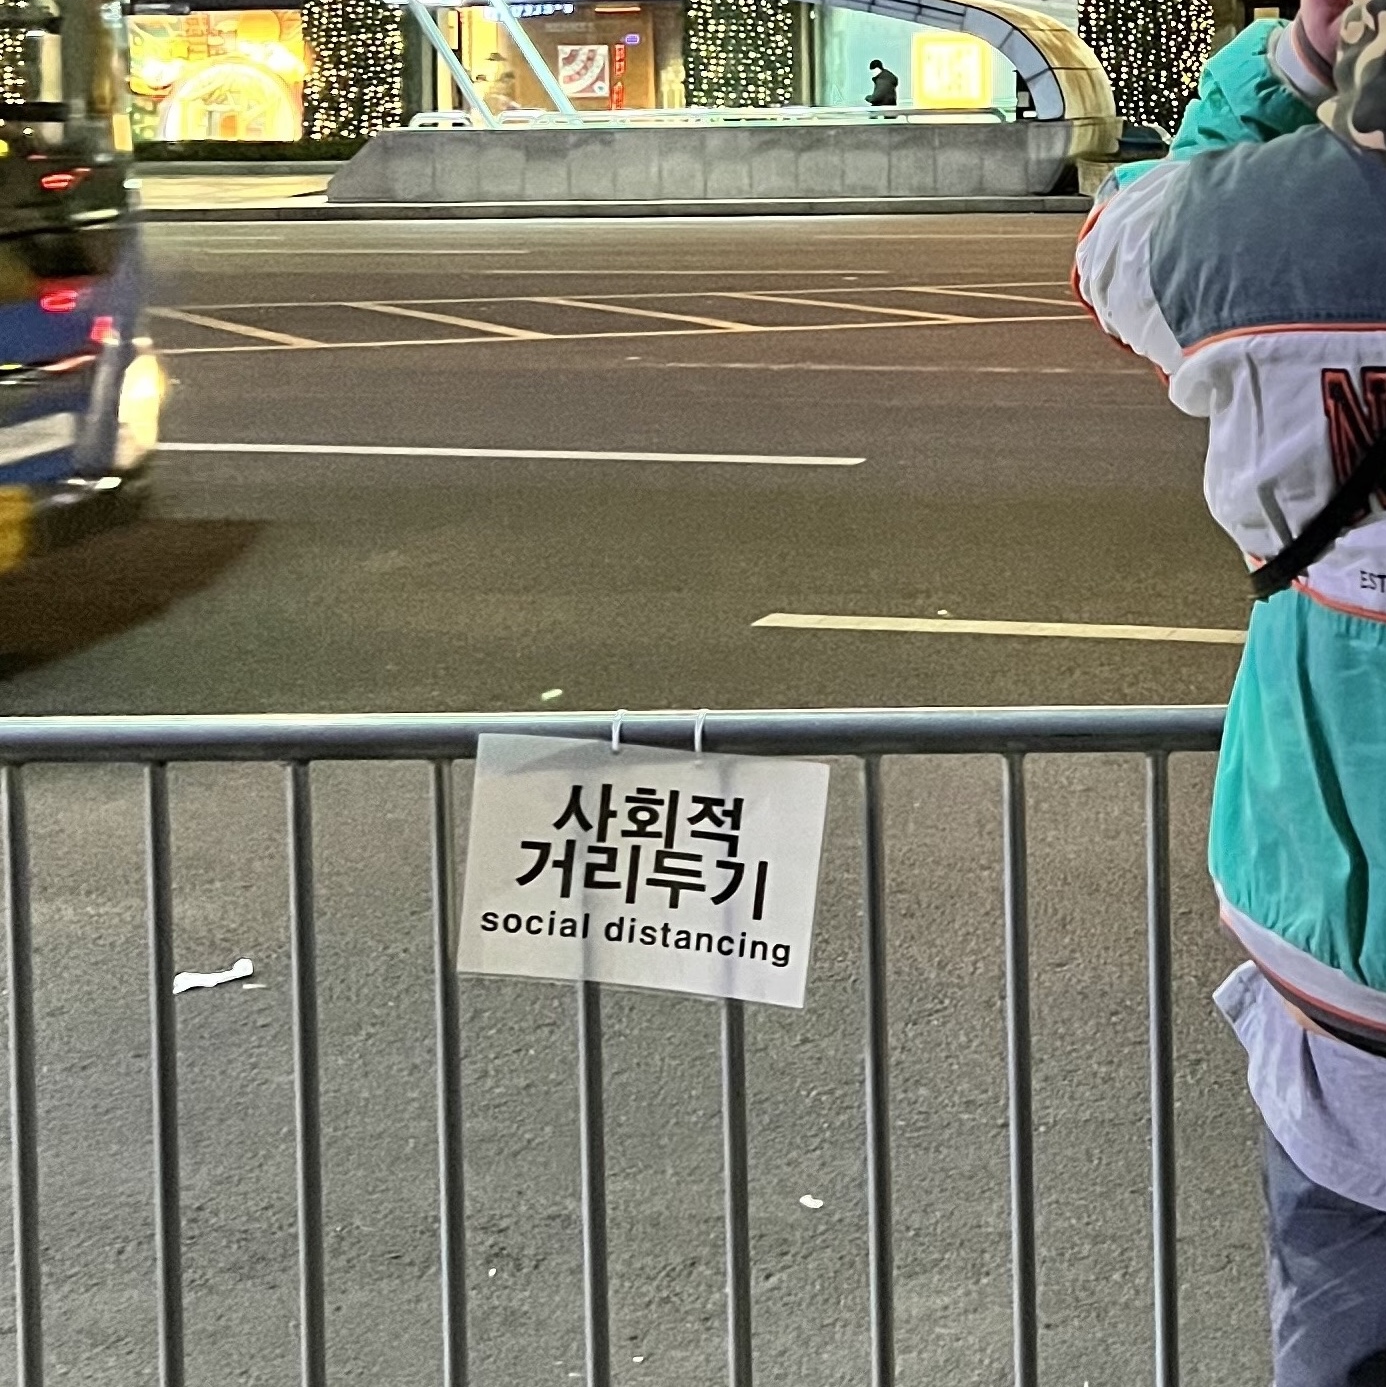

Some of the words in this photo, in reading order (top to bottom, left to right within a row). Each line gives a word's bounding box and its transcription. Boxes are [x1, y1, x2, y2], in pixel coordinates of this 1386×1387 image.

[552, 783, 745, 858] 사회적
[515, 839, 769, 921] 거리두기
[480, 910, 591, 939] social
[604, 917, 791, 967] distancing
